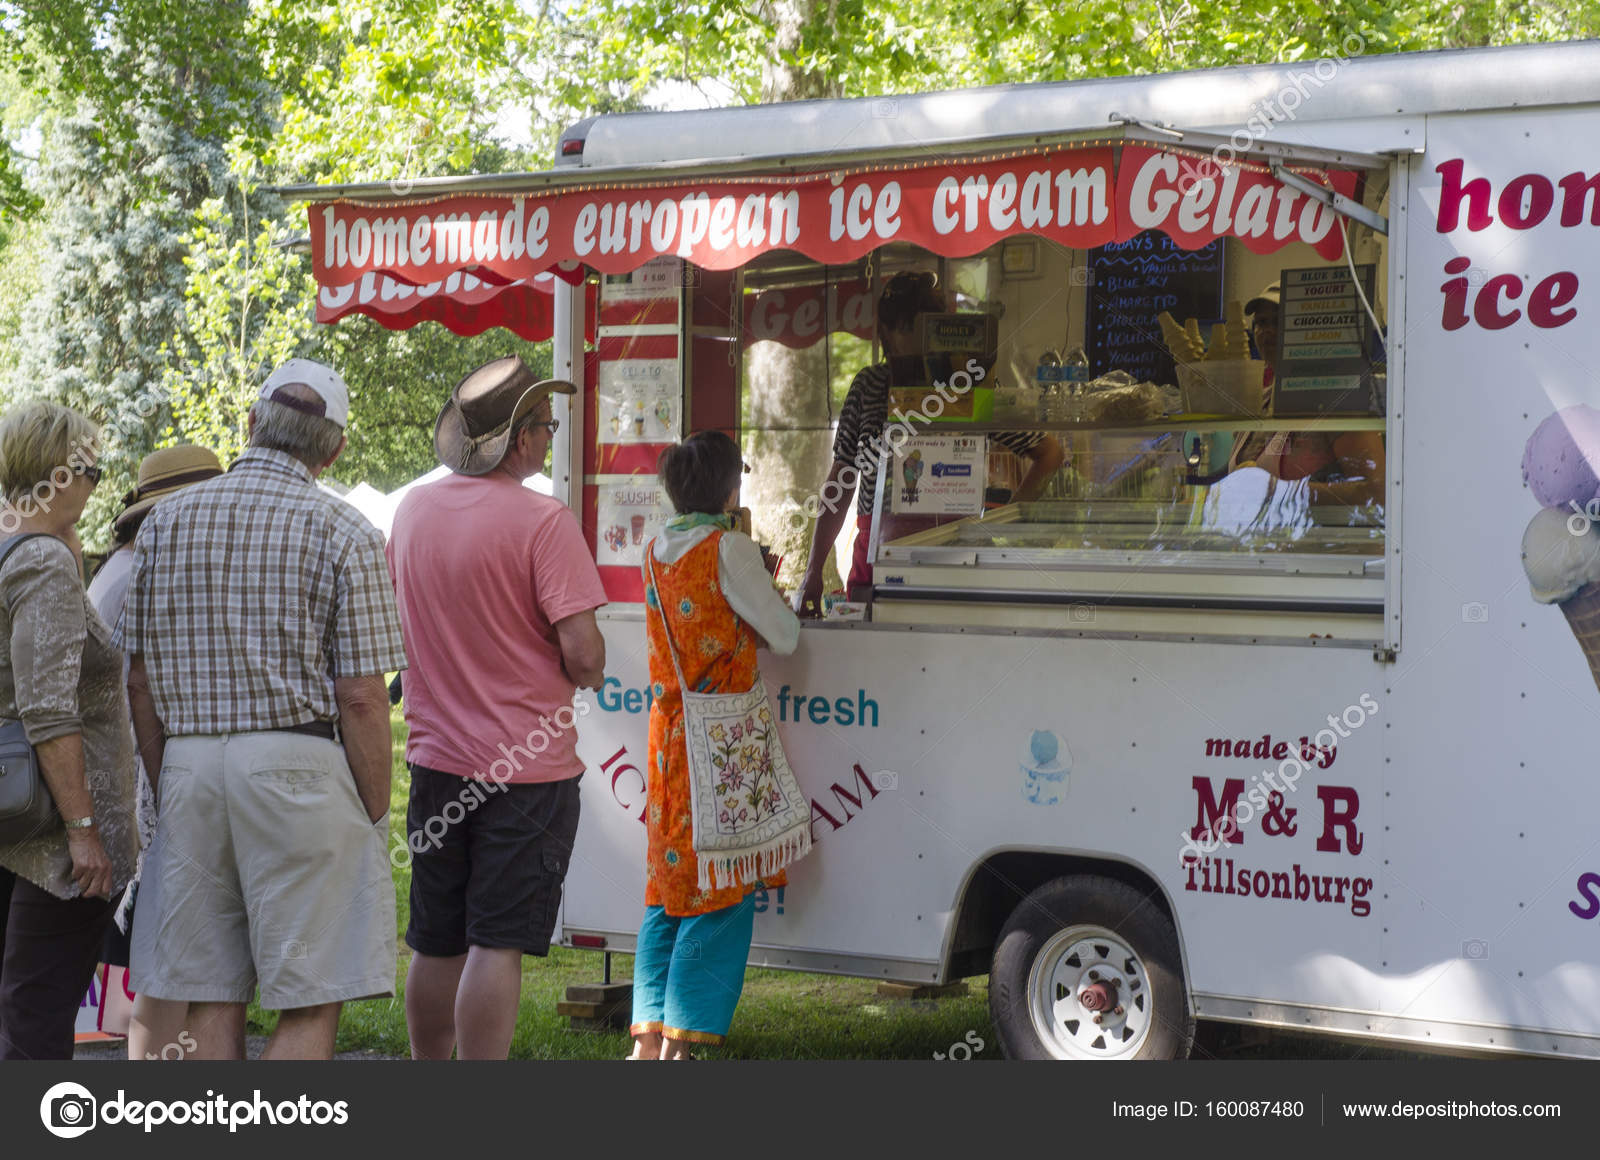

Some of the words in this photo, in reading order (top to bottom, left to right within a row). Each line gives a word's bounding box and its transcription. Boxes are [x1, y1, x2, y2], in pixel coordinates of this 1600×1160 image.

[322, 199, 549, 269] homemade
[573, 188, 800, 258] european
[828, 171, 902, 242] ice
[932, 165, 1109, 233] cream
[1129, 151, 1335, 245] Gelato
[1301, 271, 1328, 281] BLUE
[1304, 284, 1346, 296] YOGURT
[1440, 256, 1579, 331] ice
[750, 287, 873, 338] Gela
[1293, 315, 1356, 326] CHOCOLATE
[1300, 301, 1346, 312] VANILLA
[1304, 331, 1341, 340] LEMON
[615, 490, 661, 505] SLUSHIE
[777, 685, 879, 727] fresh
[1205, 734, 1289, 761] made
[1300, 736, 1338, 769] by
[600, 744, 647, 824] IC
[1191, 776, 1245, 845] M
[1261, 789, 1298, 837] &
[1316, 785, 1364, 856] R
[1182, 857, 1373, 917] Tillsonburg
